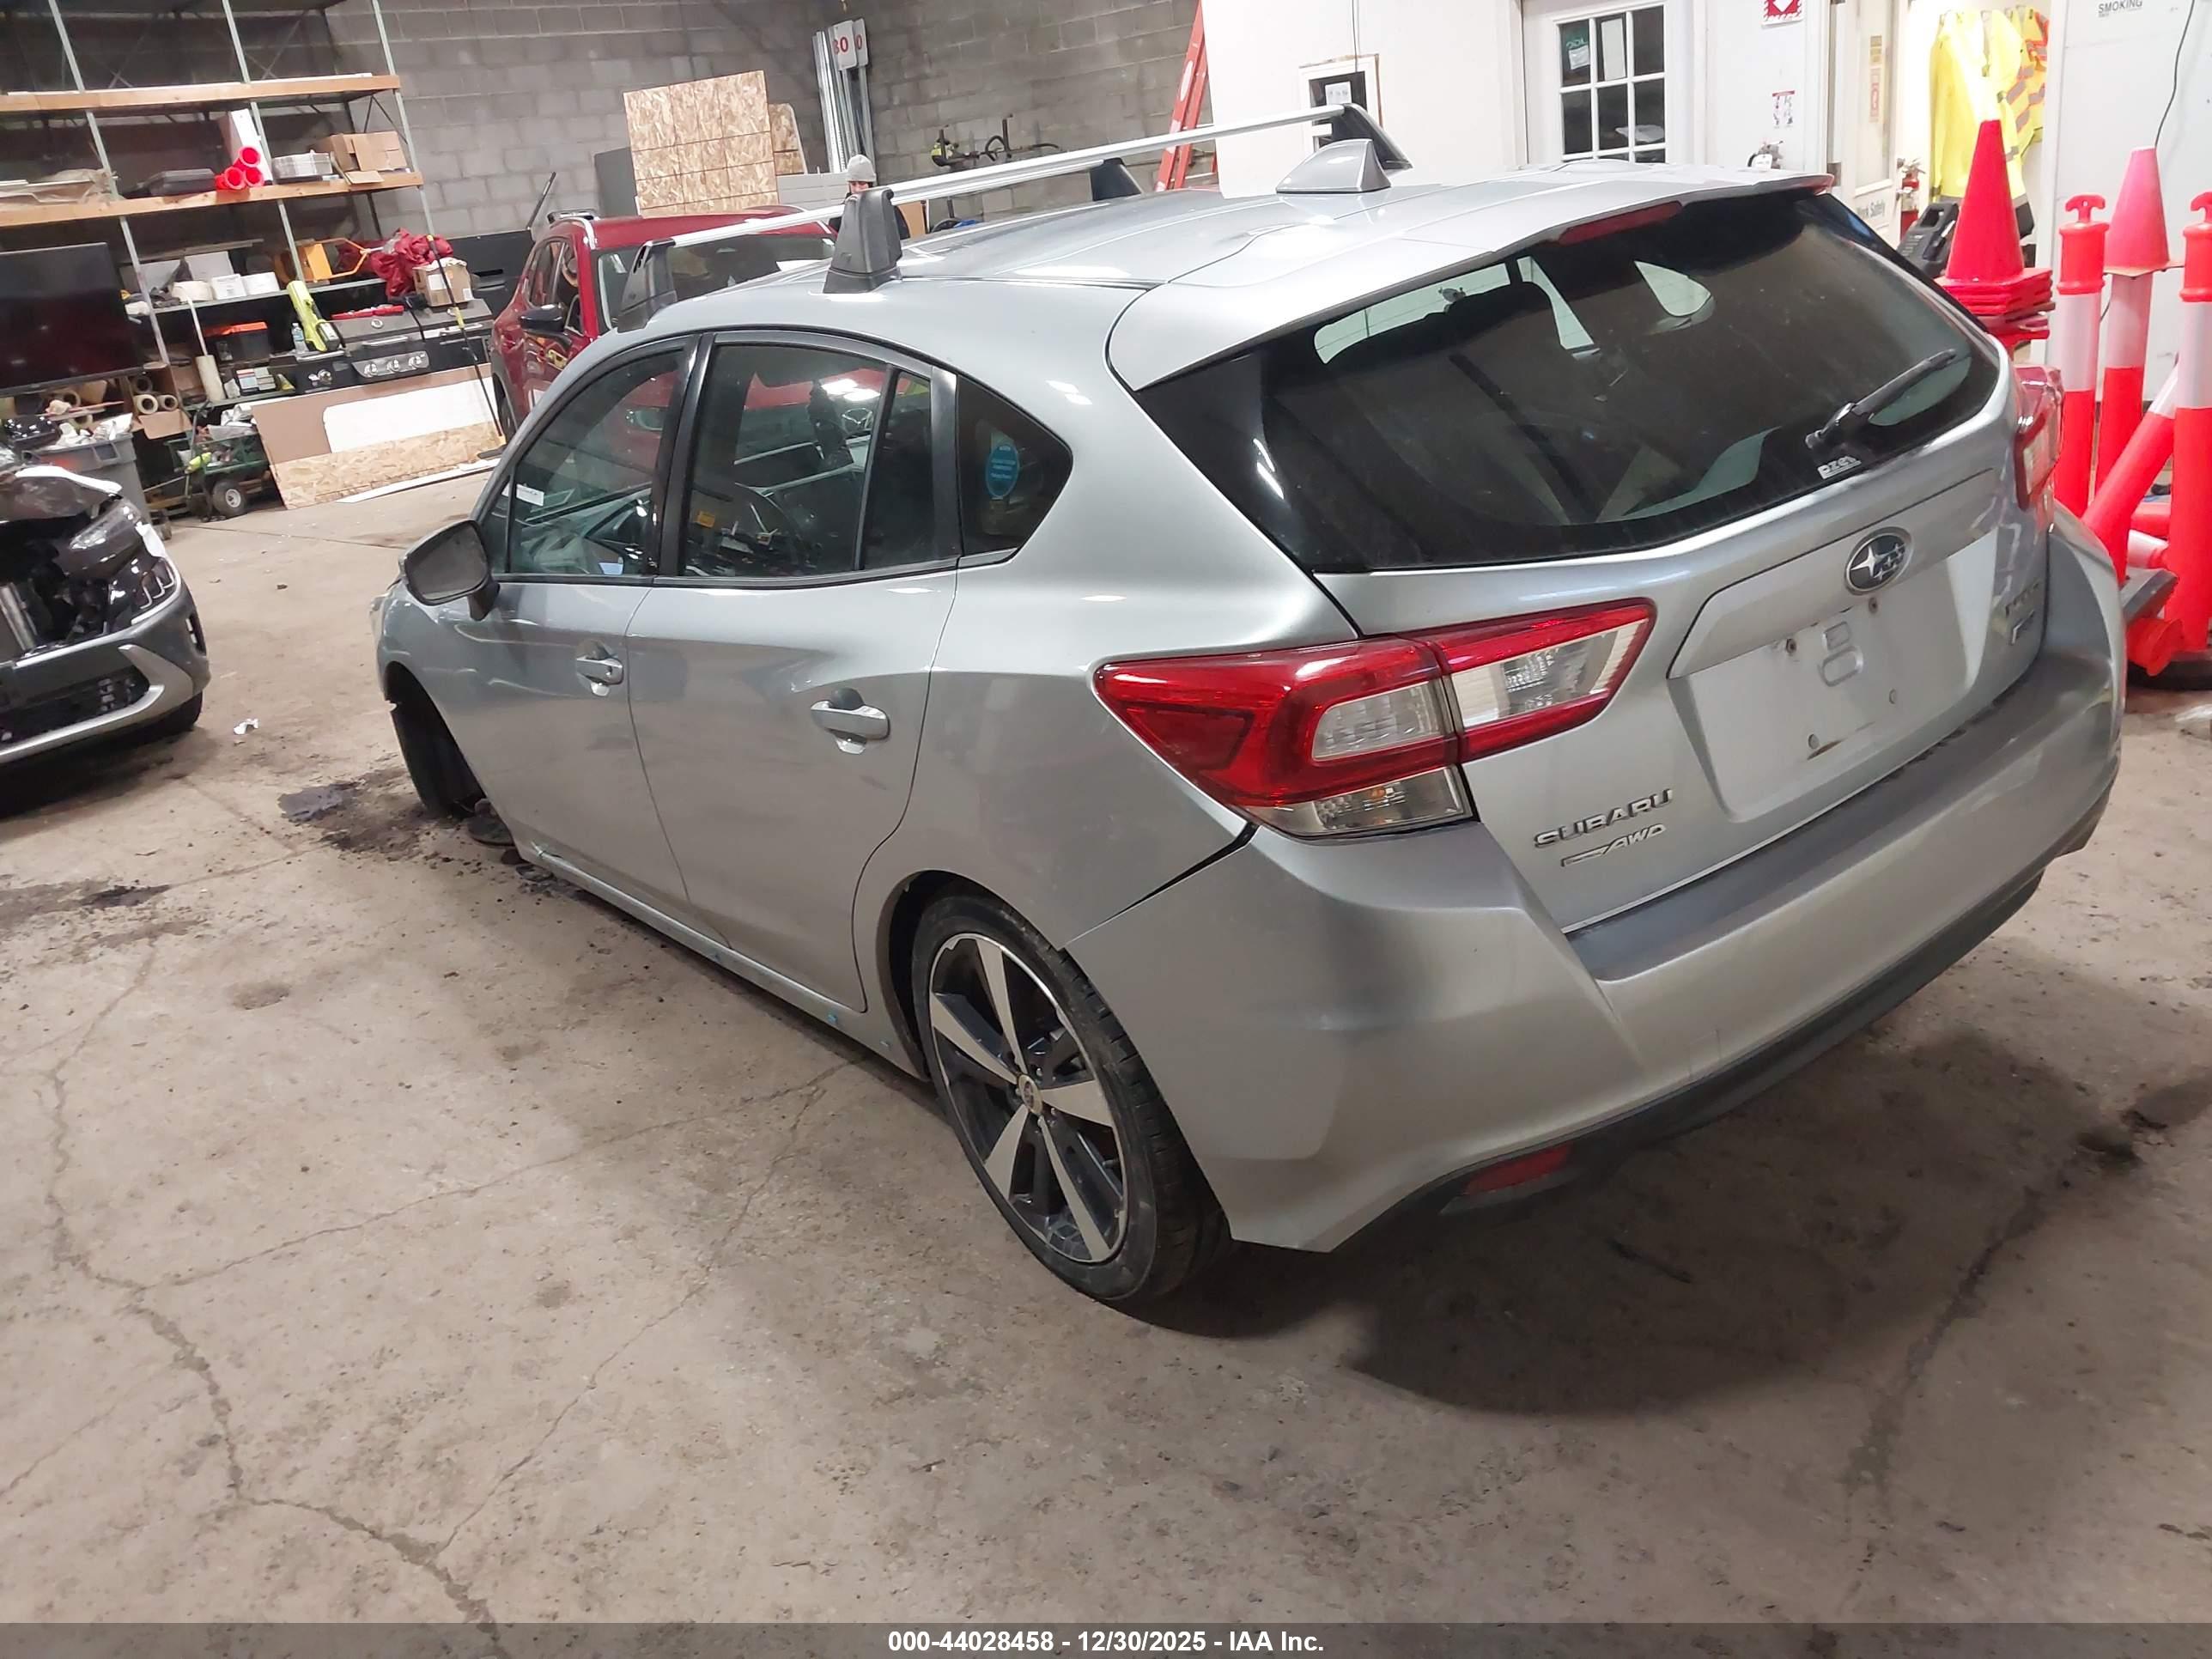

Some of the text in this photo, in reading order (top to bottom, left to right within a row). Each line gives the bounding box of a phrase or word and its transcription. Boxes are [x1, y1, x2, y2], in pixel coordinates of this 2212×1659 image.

[2098, 0, 2142, 14] SMOKING
[1534, 788, 1673, 848] SUBARU
[1603, 823, 1667, 854] AWD
